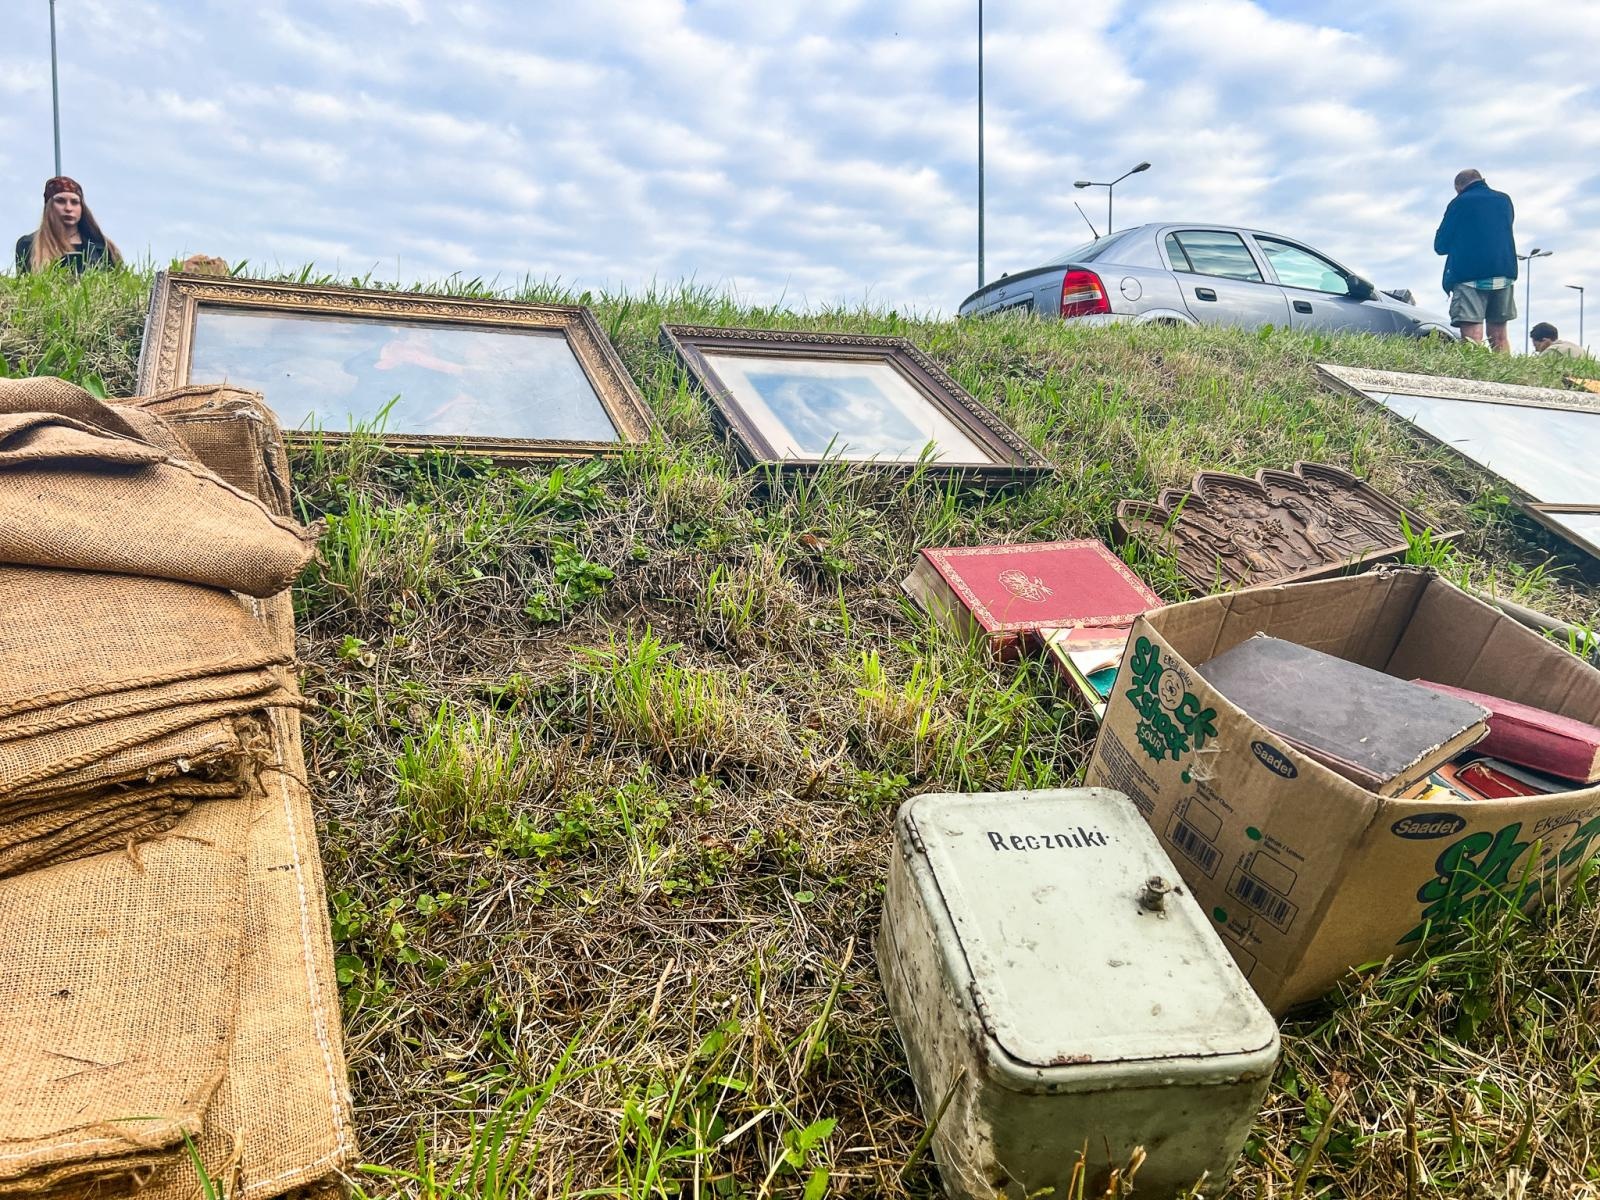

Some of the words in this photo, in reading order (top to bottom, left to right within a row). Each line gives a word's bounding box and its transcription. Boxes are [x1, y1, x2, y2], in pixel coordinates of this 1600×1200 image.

[1140, 726, 1162, 751] SOUR
[1253, 743, 1295, 778] Saadet
[986, 825, 1108, 852] Ręczniki
[1395, 819, 1460, 835] Saadet
